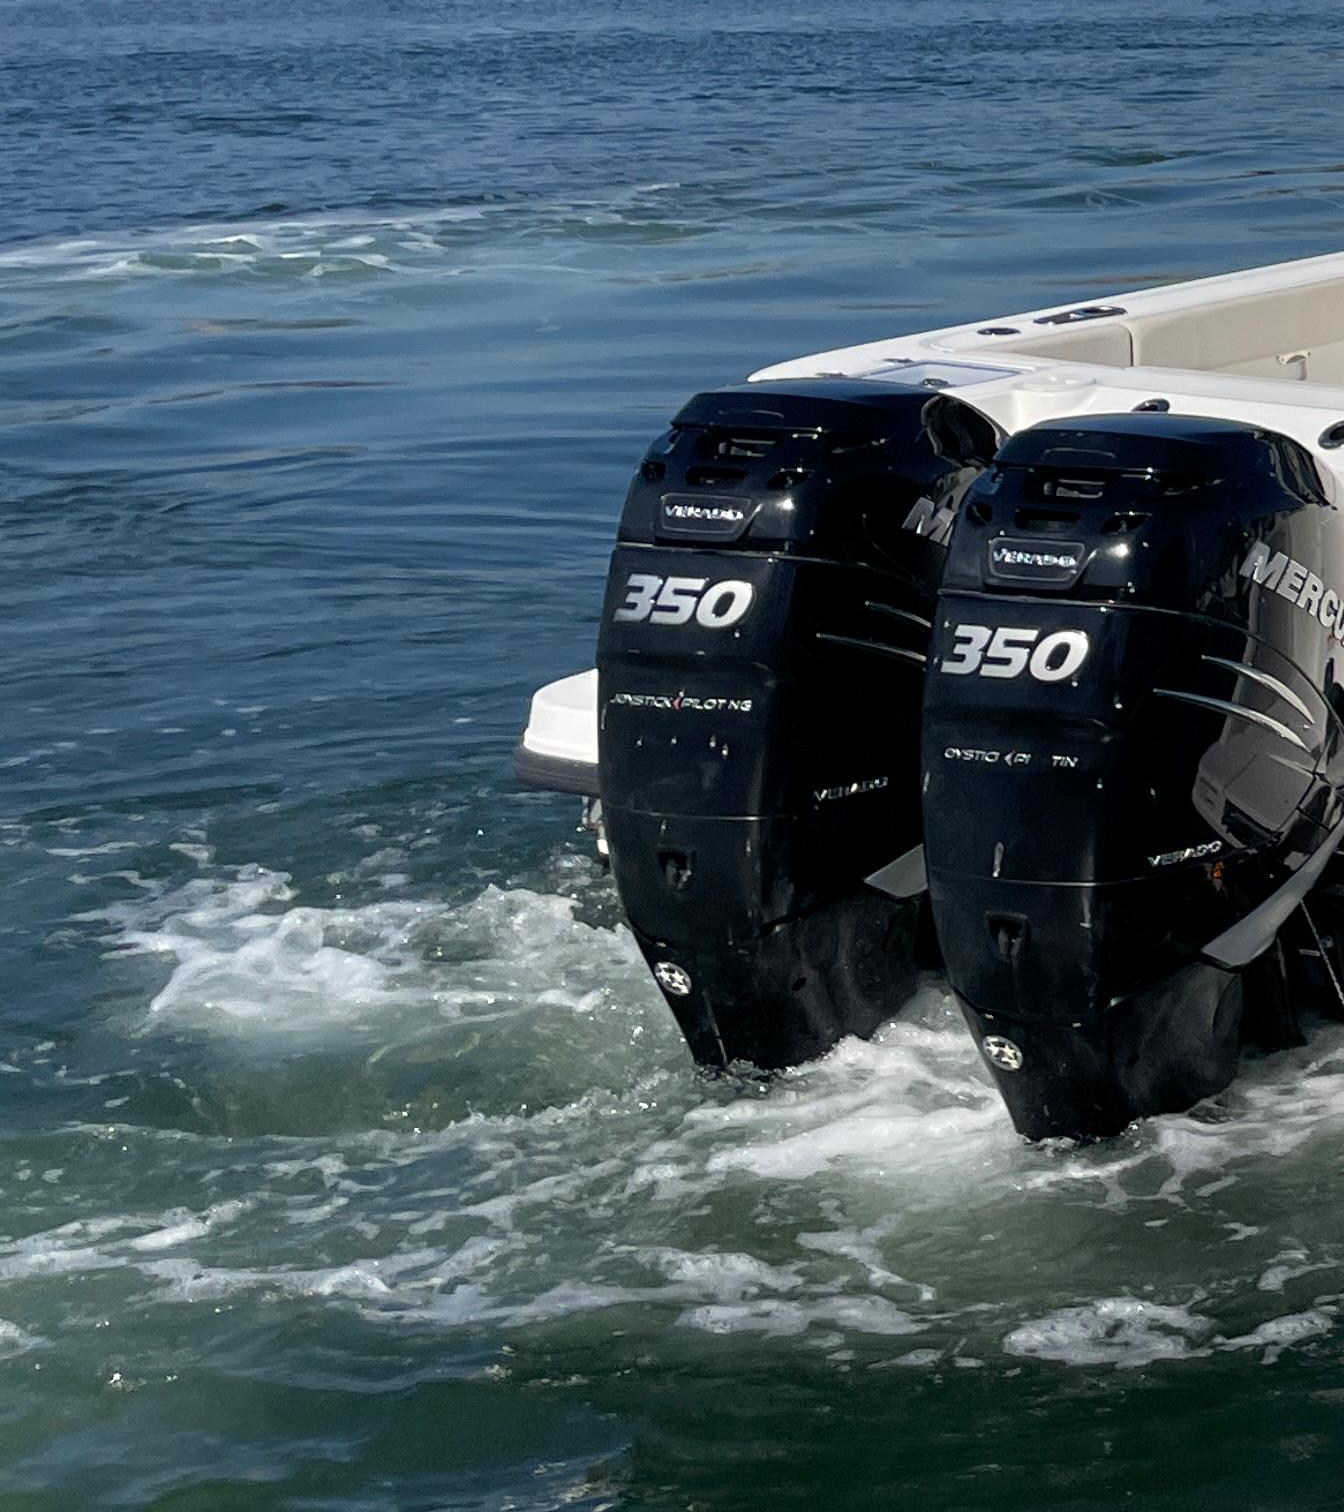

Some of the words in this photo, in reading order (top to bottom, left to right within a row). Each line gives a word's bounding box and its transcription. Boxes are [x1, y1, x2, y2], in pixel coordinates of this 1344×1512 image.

[993, 548, 1077, 568] VERADO
[613, 573, 754, 628] 350
[940, 624, 1089, 682] 350
[1147, 840, 1222, 868] VERADO
